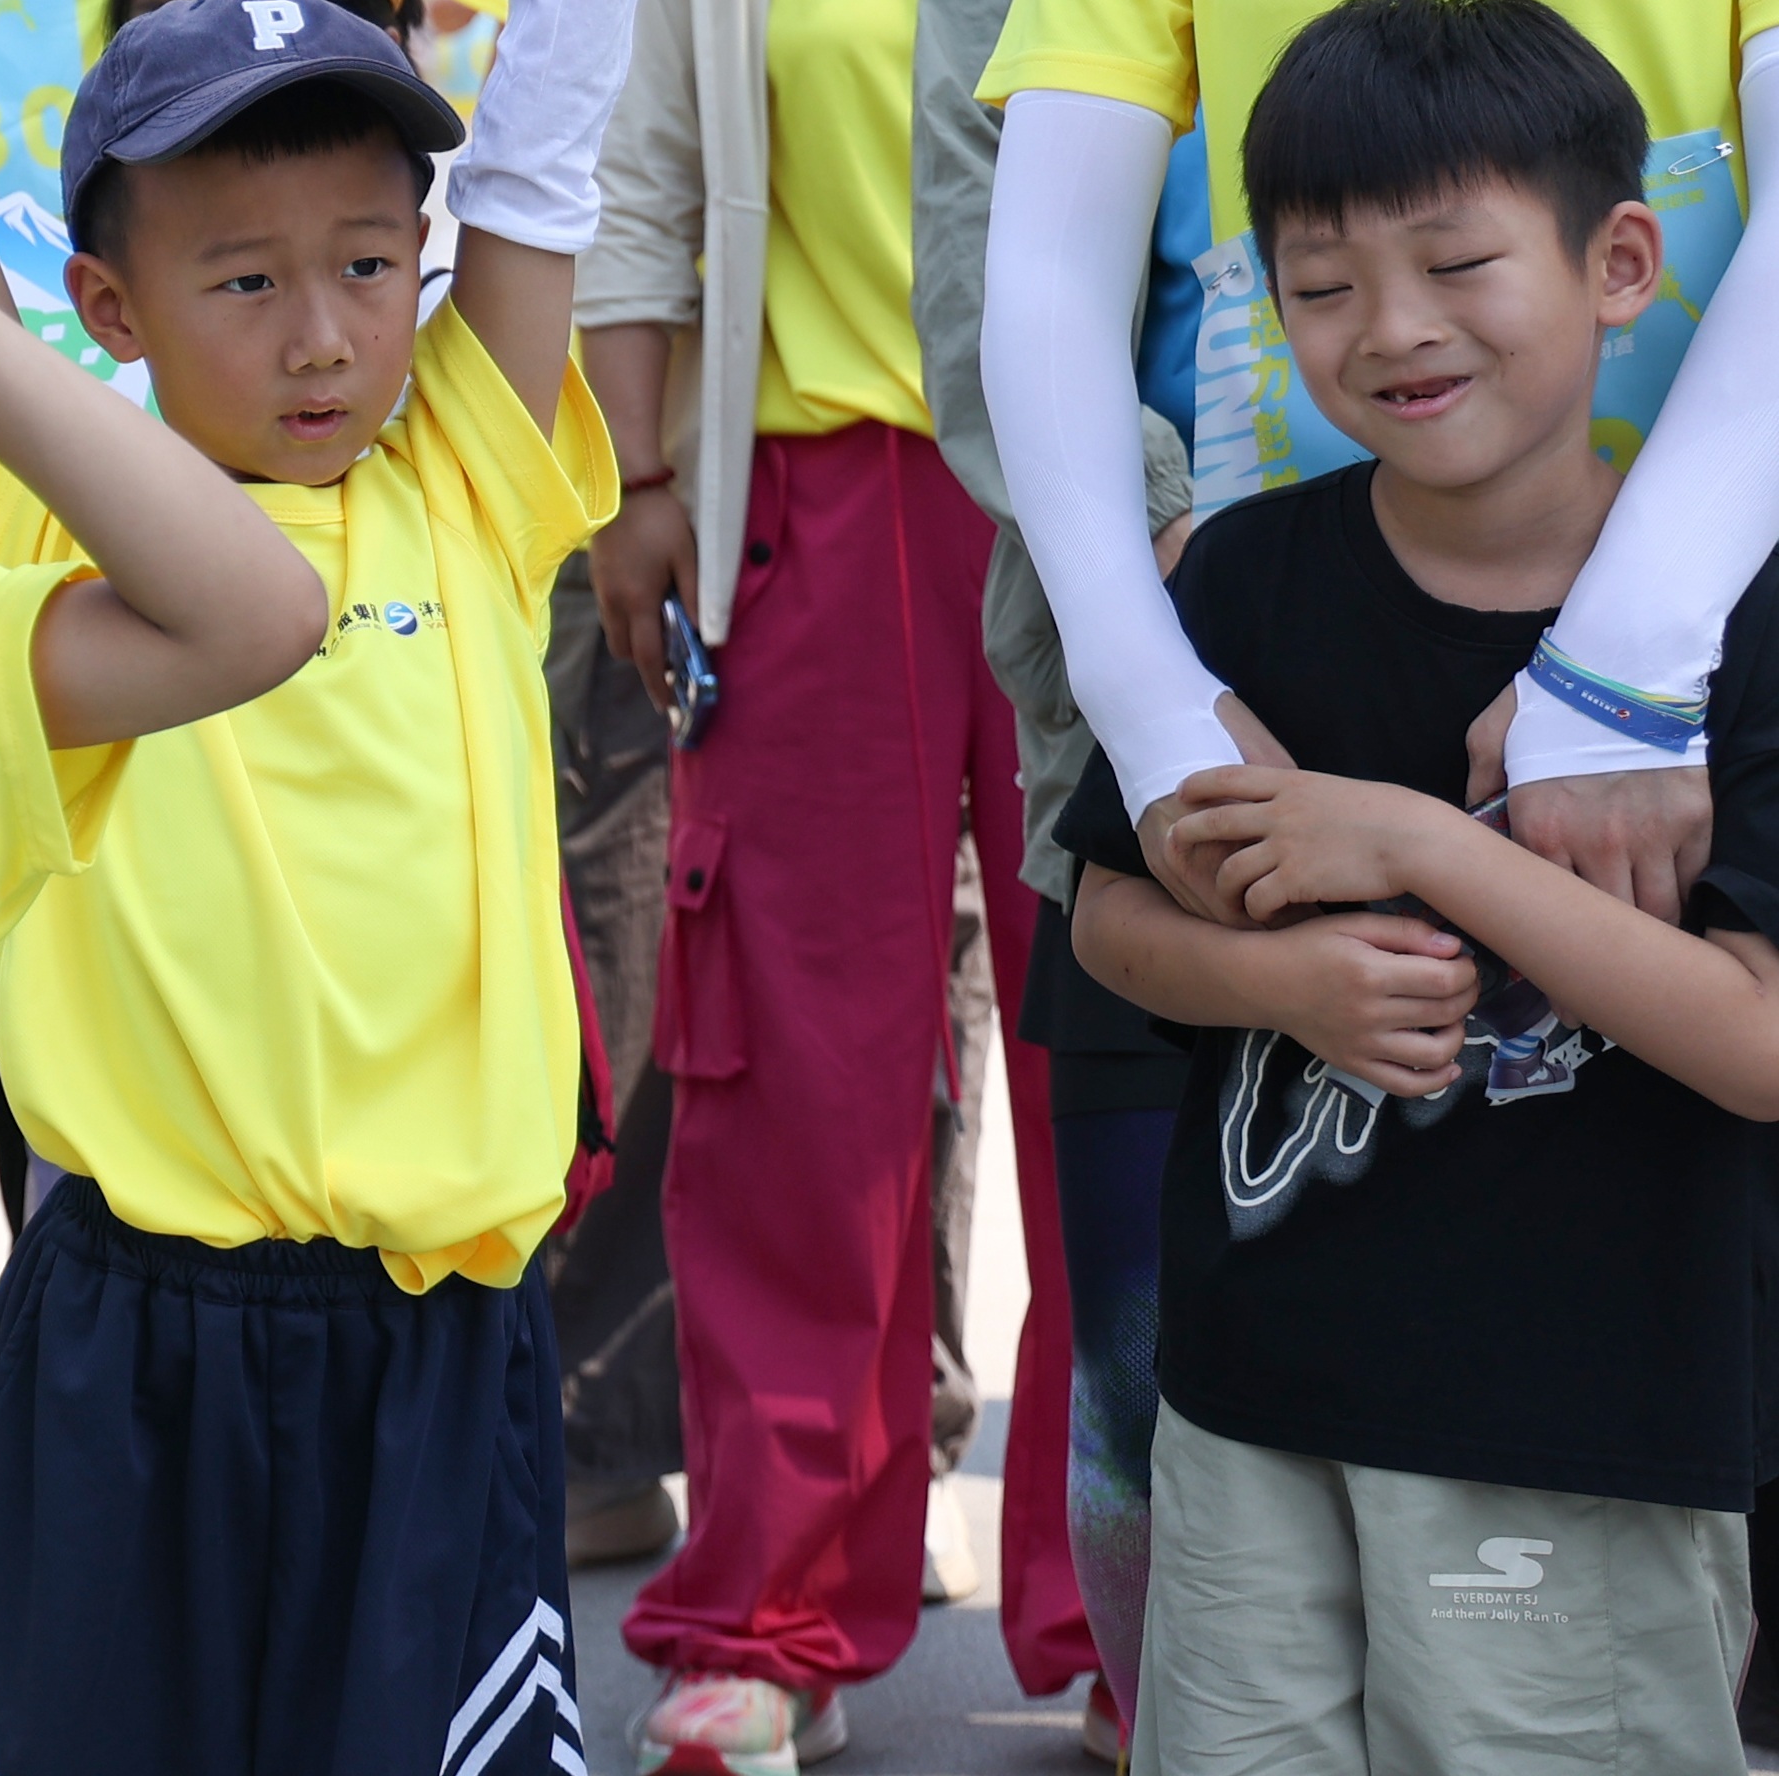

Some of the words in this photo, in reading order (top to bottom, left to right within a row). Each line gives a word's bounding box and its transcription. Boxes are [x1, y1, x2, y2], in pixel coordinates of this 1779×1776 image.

[241, 0, 305, 51] P
[1453, 1592, 1511, 1605] EVERDAY
[1430, 1607, 1453, 1619] And
[1455, 1607, 1487, 1620] them
[1490, 1609, 1520, 1623] Jolly
[1524, 1610, 1550, 1623] Ran
[1553, 1612, 1569, 1624] To
